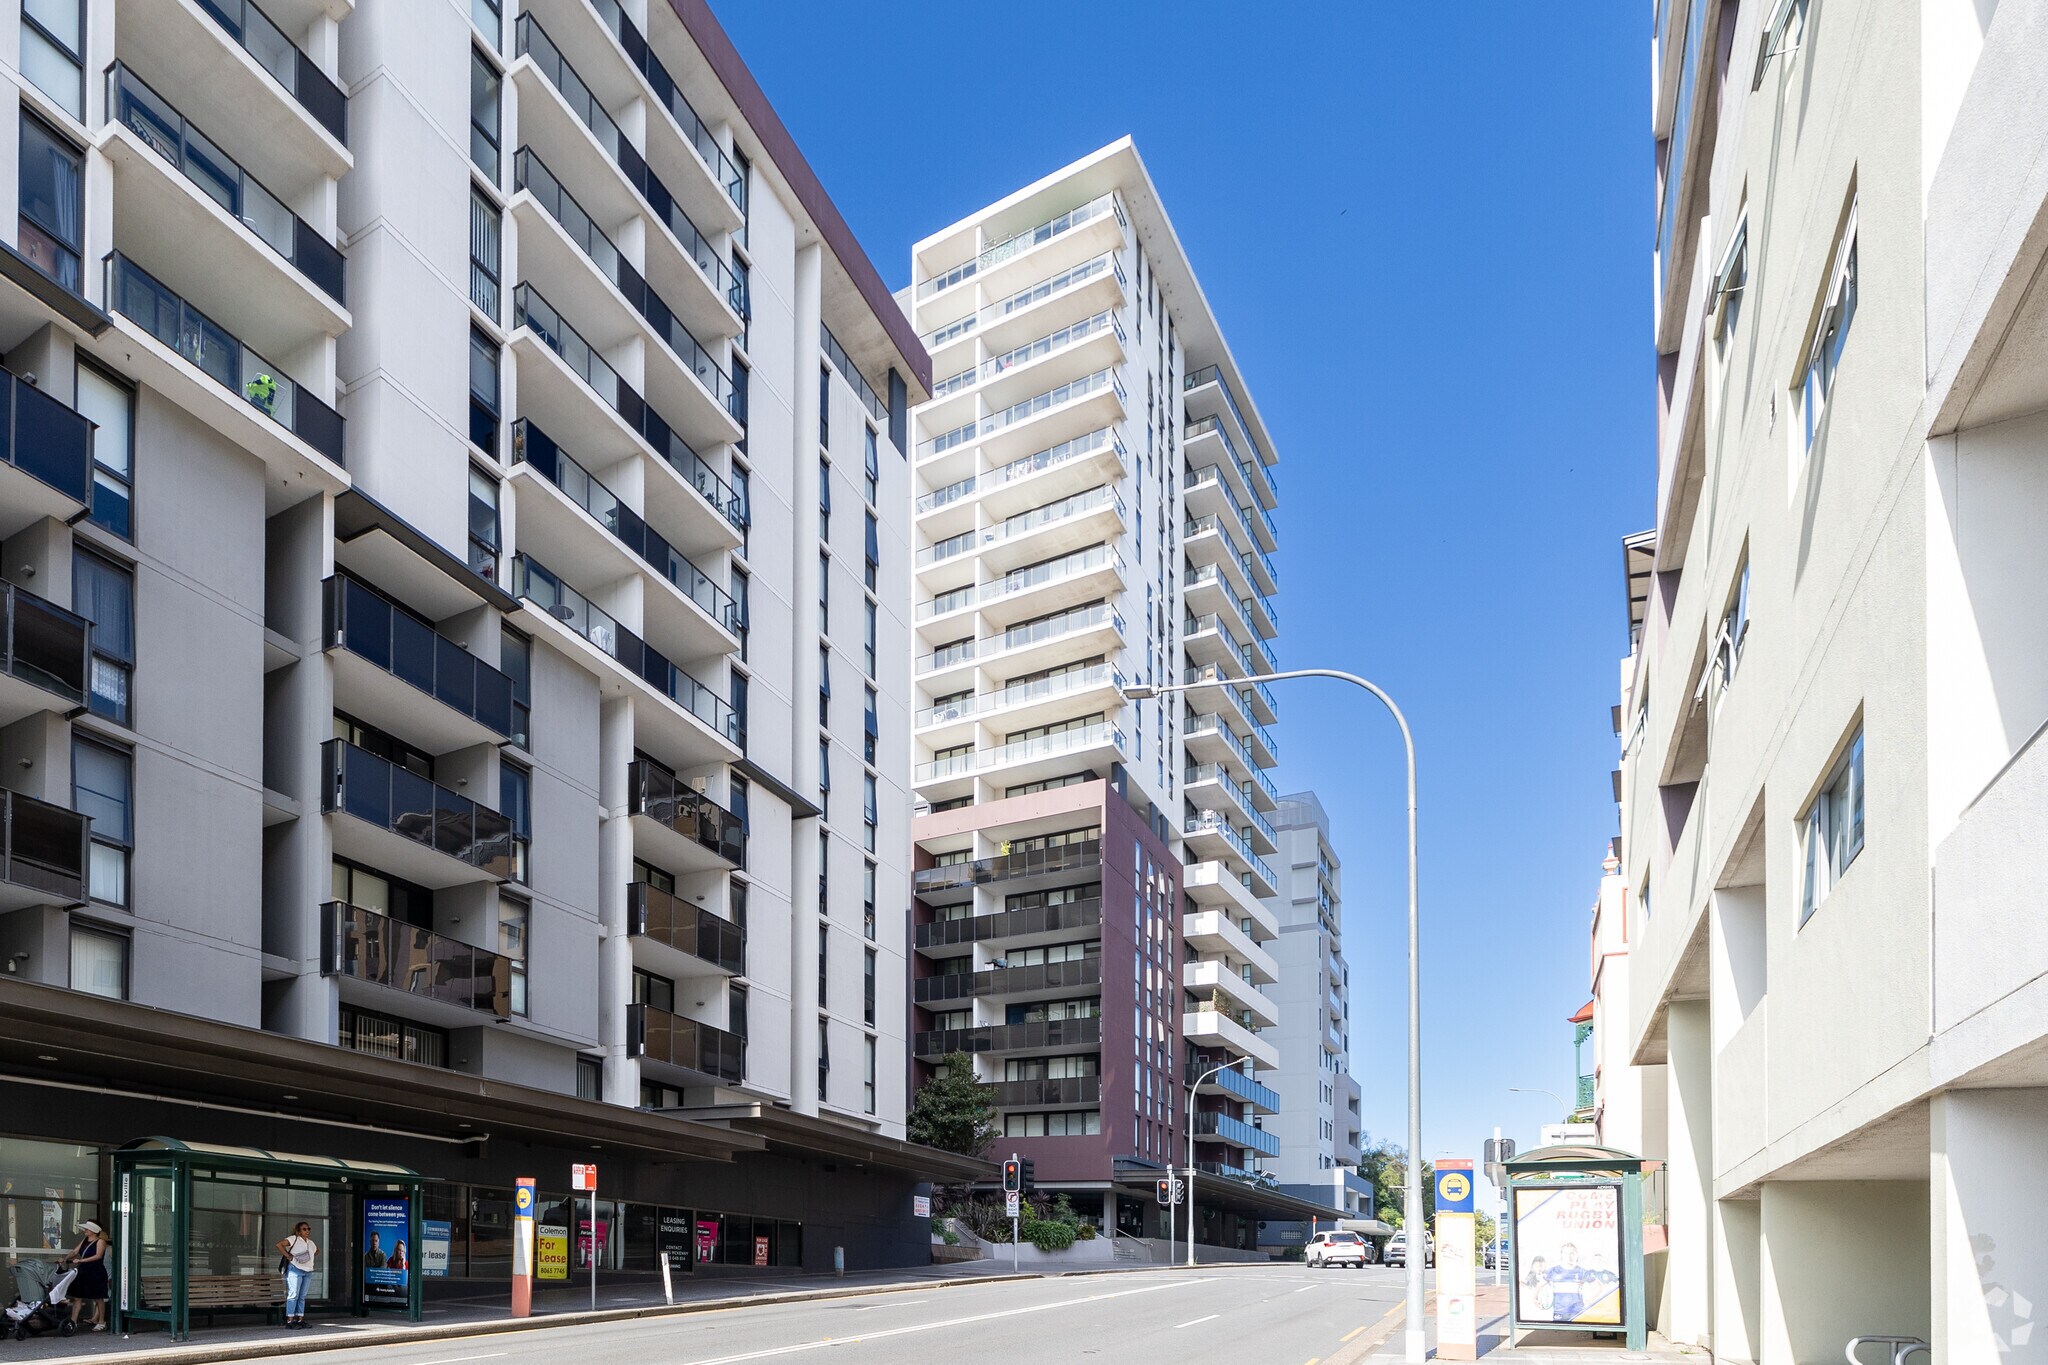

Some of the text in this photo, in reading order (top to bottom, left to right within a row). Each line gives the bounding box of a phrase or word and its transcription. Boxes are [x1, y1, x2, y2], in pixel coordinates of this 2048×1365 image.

[1570, 1201, 1615, 1210] PLAY
[1556, 1210, 1615, 1219] RUGBY
[663, 1216, 685, 1225] LEASING
[1562, 1220, 1615, 1229] UNION
[660, 1225, 688, 1234] ENQUIRIES
[540, 1238, 555, 1250] For
[428, 1250, 447, 1260] lease
[539, 1251, 567, 1264] Lease
